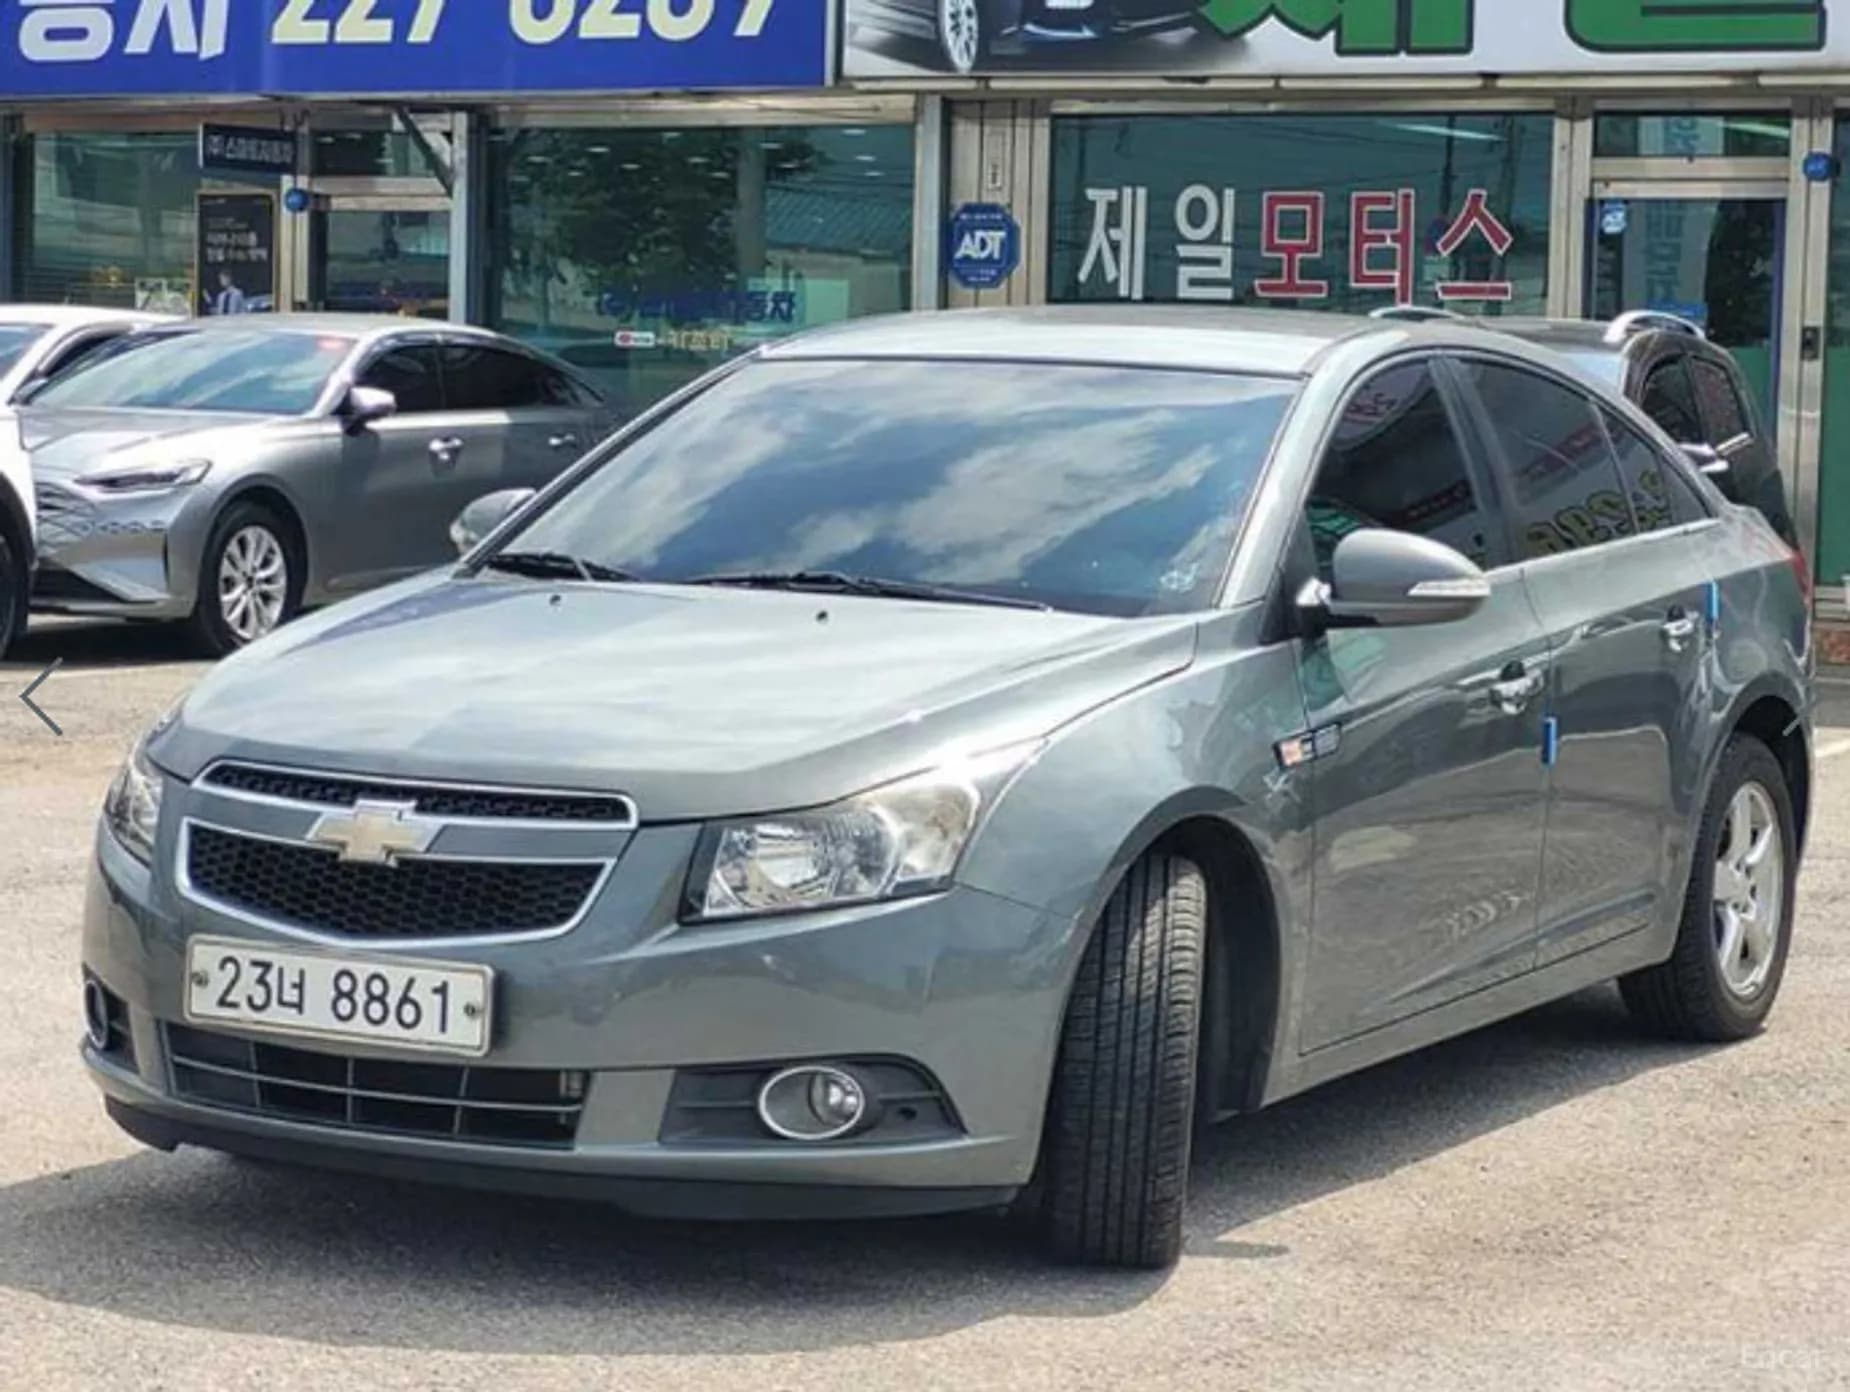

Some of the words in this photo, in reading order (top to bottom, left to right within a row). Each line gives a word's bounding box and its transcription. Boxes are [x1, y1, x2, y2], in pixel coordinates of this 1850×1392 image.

[954, 230, 1006, 260] ADT
[216, 956, 305, 1015] 23너
[331, 968, 449, 1034] 8861
